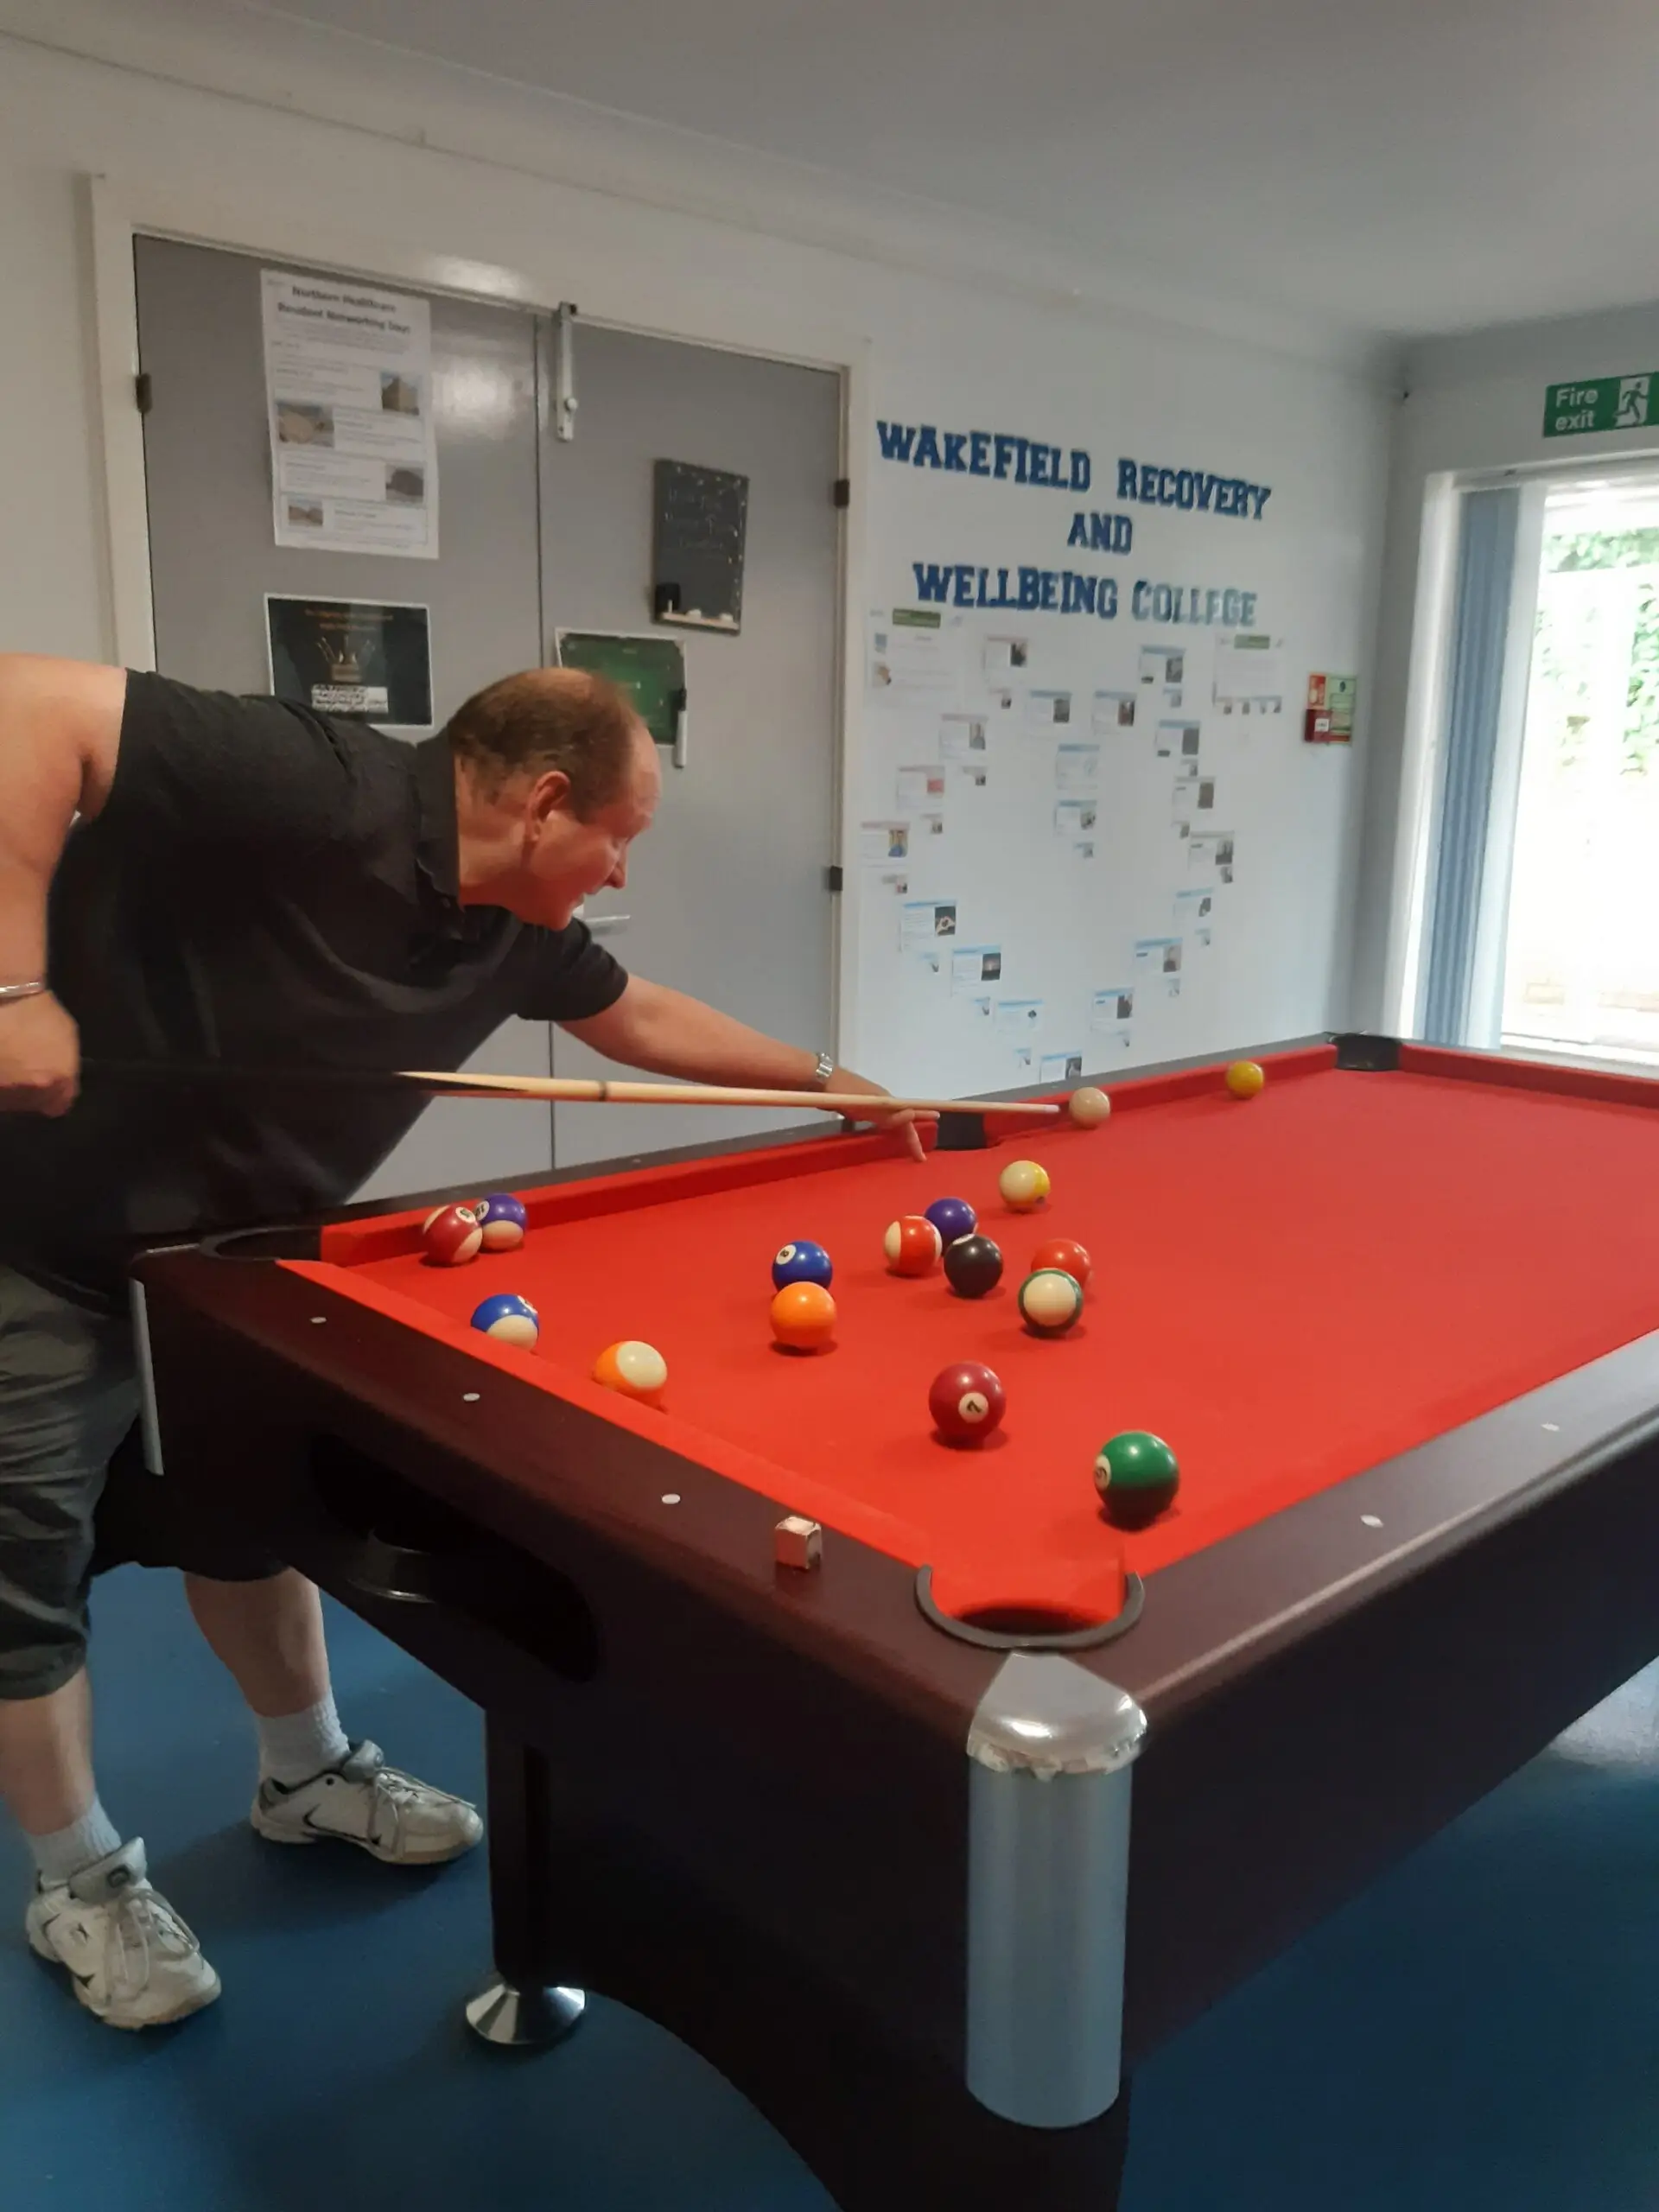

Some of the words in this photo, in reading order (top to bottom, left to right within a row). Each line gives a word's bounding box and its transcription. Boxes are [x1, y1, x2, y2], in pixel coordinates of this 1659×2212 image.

[1555, 387, 1599, 408] Fire
[1555, 410, 1595, 431] exit
[876, 420, 1090, 493] WAKEFIELD
[1117, 458, 1272, 521] RECOVERY
[1067, 512, 1133, 555] AND
[912, 562, 1118, 620] WELLBEING
[1131, 579, 1258, 627] COLLEGE
